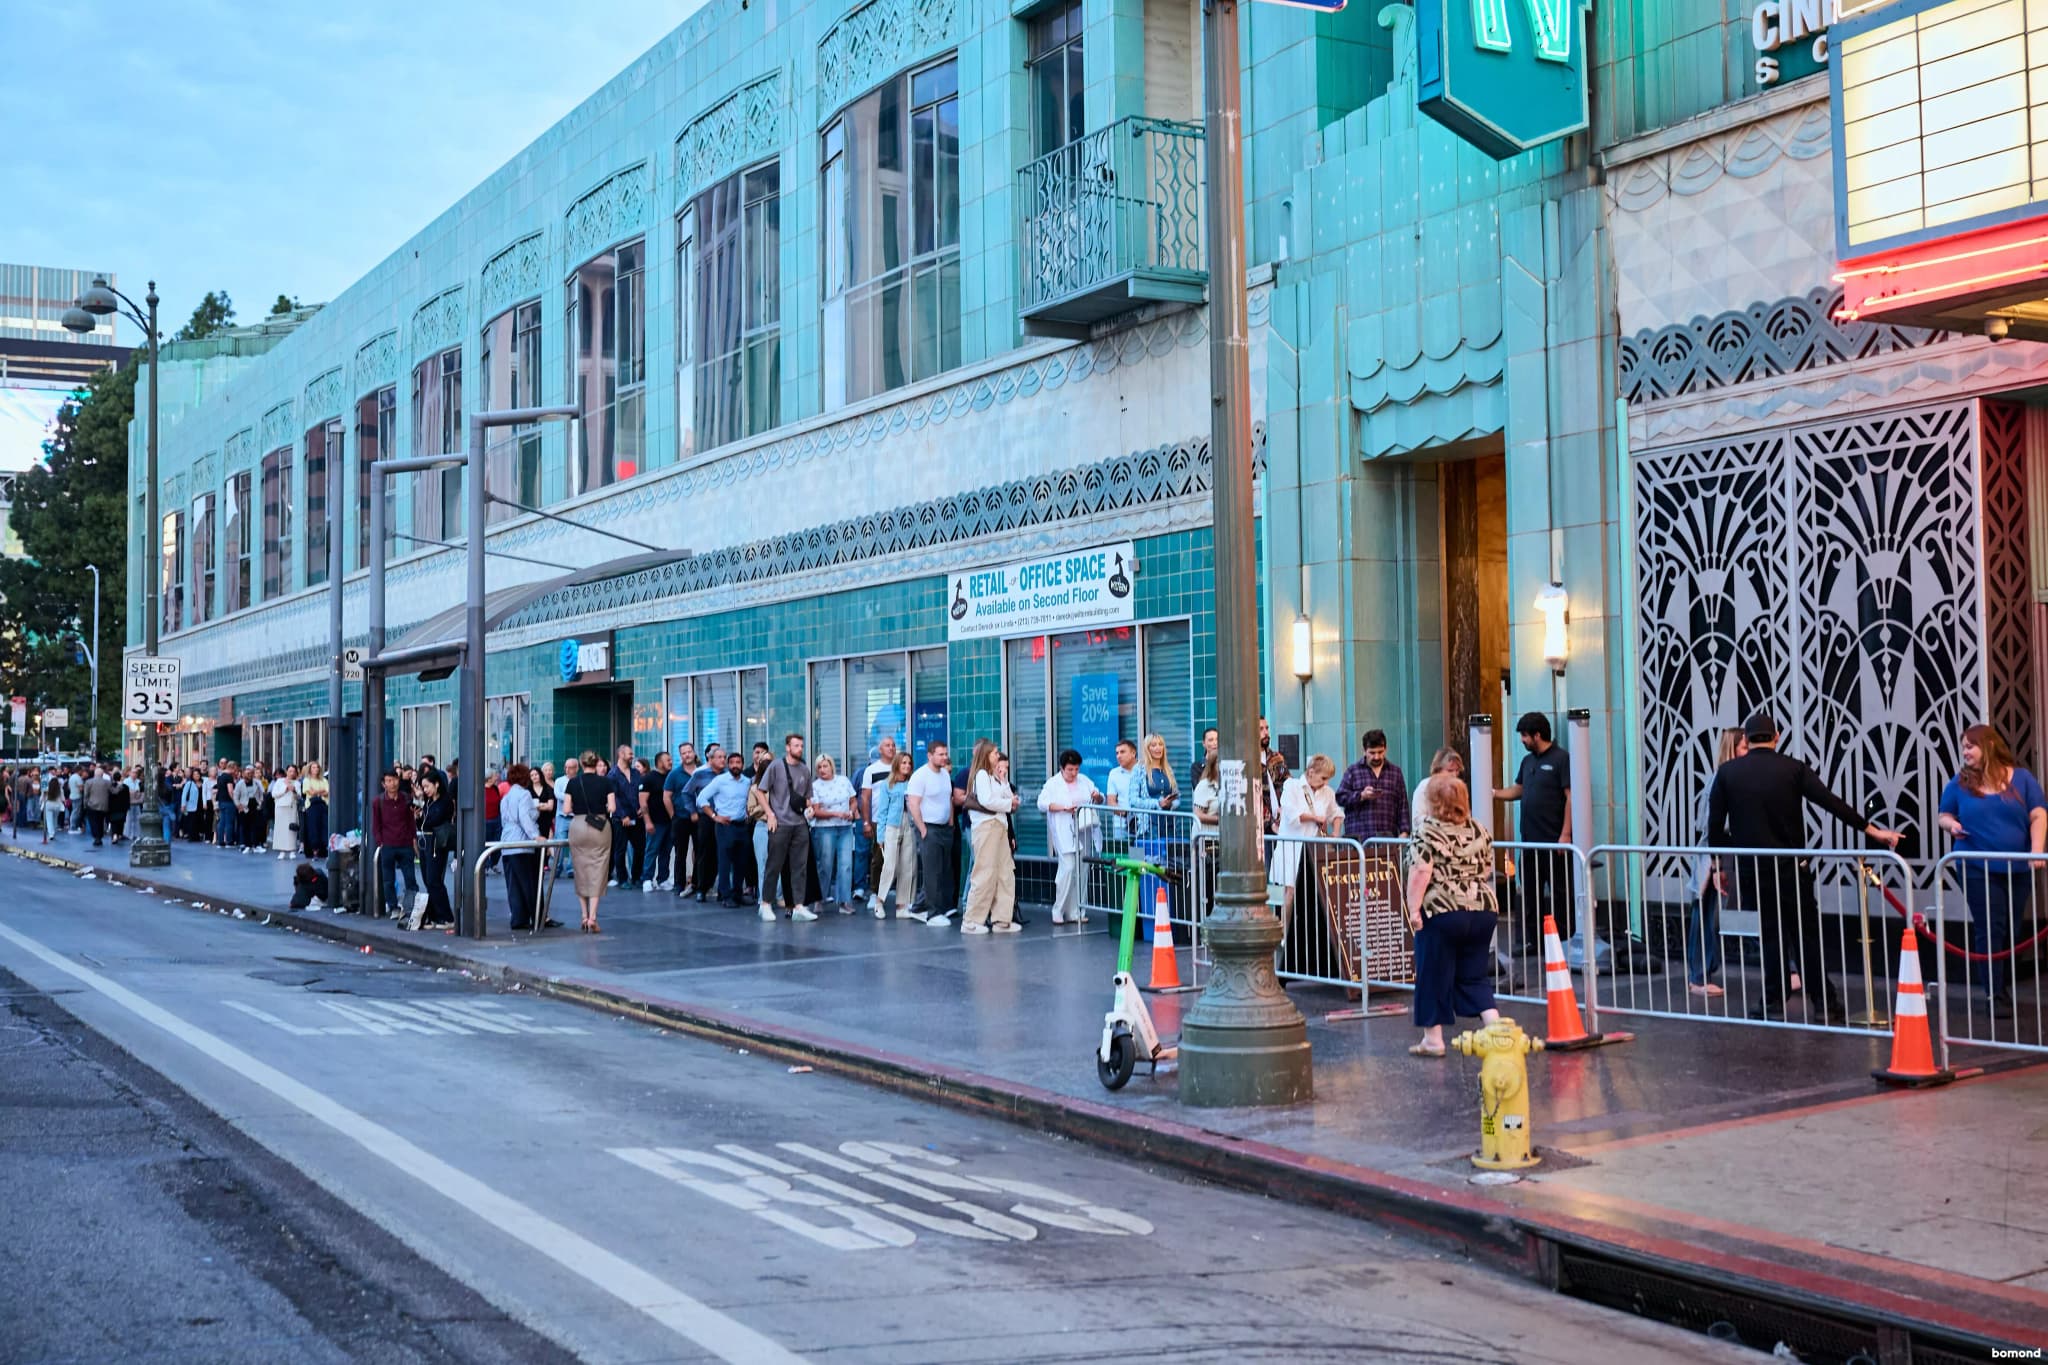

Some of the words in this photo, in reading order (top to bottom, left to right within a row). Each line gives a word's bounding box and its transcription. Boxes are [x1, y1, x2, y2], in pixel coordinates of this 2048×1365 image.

[969, 570, 1008, 599] RETAIL
[1019, 561, 1062, 592] OFFICE
[1065, 553, 1106, 584] SPACE
[975, 597, 1016, 617] Available
[1018, 598, 1031, 611] on
[1033, 588, 1070, 609] Second
[1072, 587, 1099, 604] Floor
[131, 663, 176, 673] SPEED
[345, 670, 360, 678] 720
[135, 678, 170, 688] LIMIT
[1081, 684, 1108, 702] Save
[131, 692, 173, 715] 35
[1081, 703, 1109, 723] 20%
[1081, 735, 1109, 745] Internet
[219, 999, 592, 1036] LANE
[603, 1141, 1154, 1250] BUS
